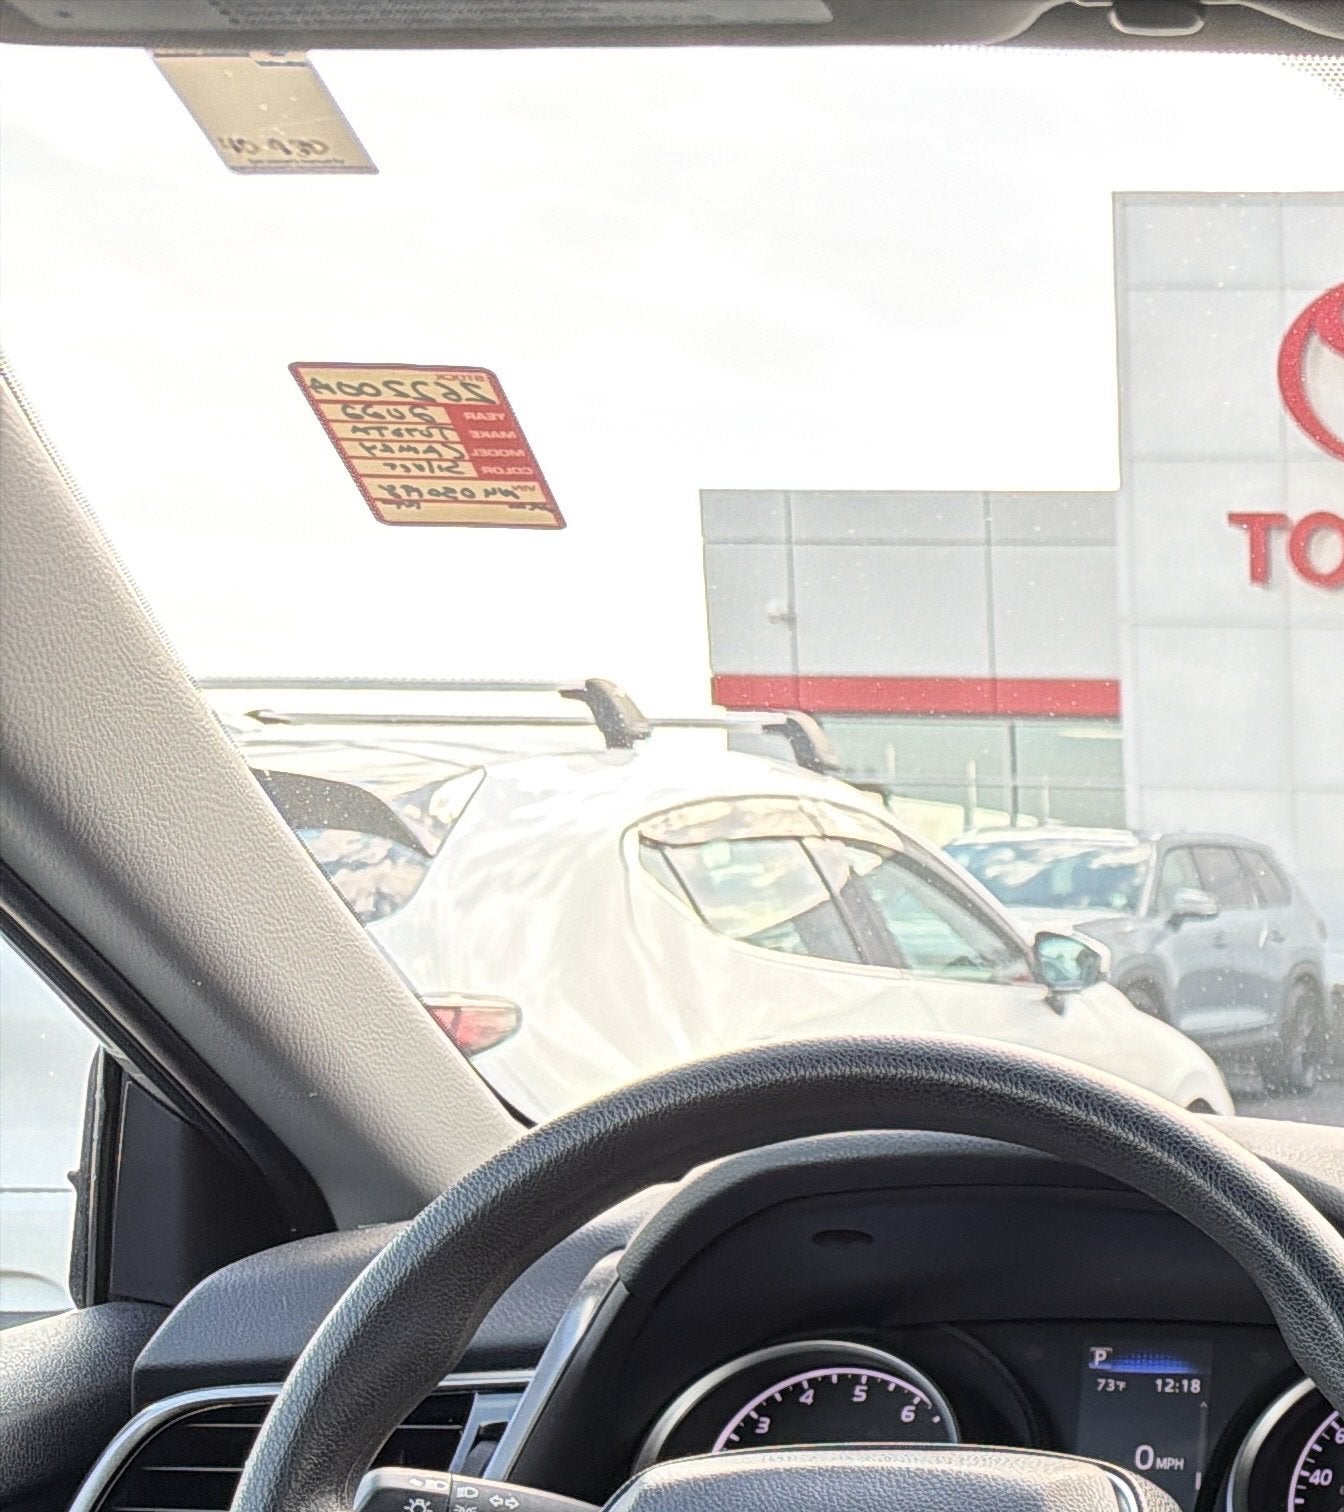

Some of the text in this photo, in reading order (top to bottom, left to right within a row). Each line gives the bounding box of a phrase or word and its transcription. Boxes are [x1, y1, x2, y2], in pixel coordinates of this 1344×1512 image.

[851, 1386, 868, 1402] 5
[1155, 1379, 1201, 1394] 12:18
[800, 1388, 814, 1405] 4
[900, 1405, 915, 1422] 6
[754, 1416, 771, 1434] 3
[1135, 1445, 1184, 1471] 0 MPH
[1309, 1469, 1332, 1486] 40
